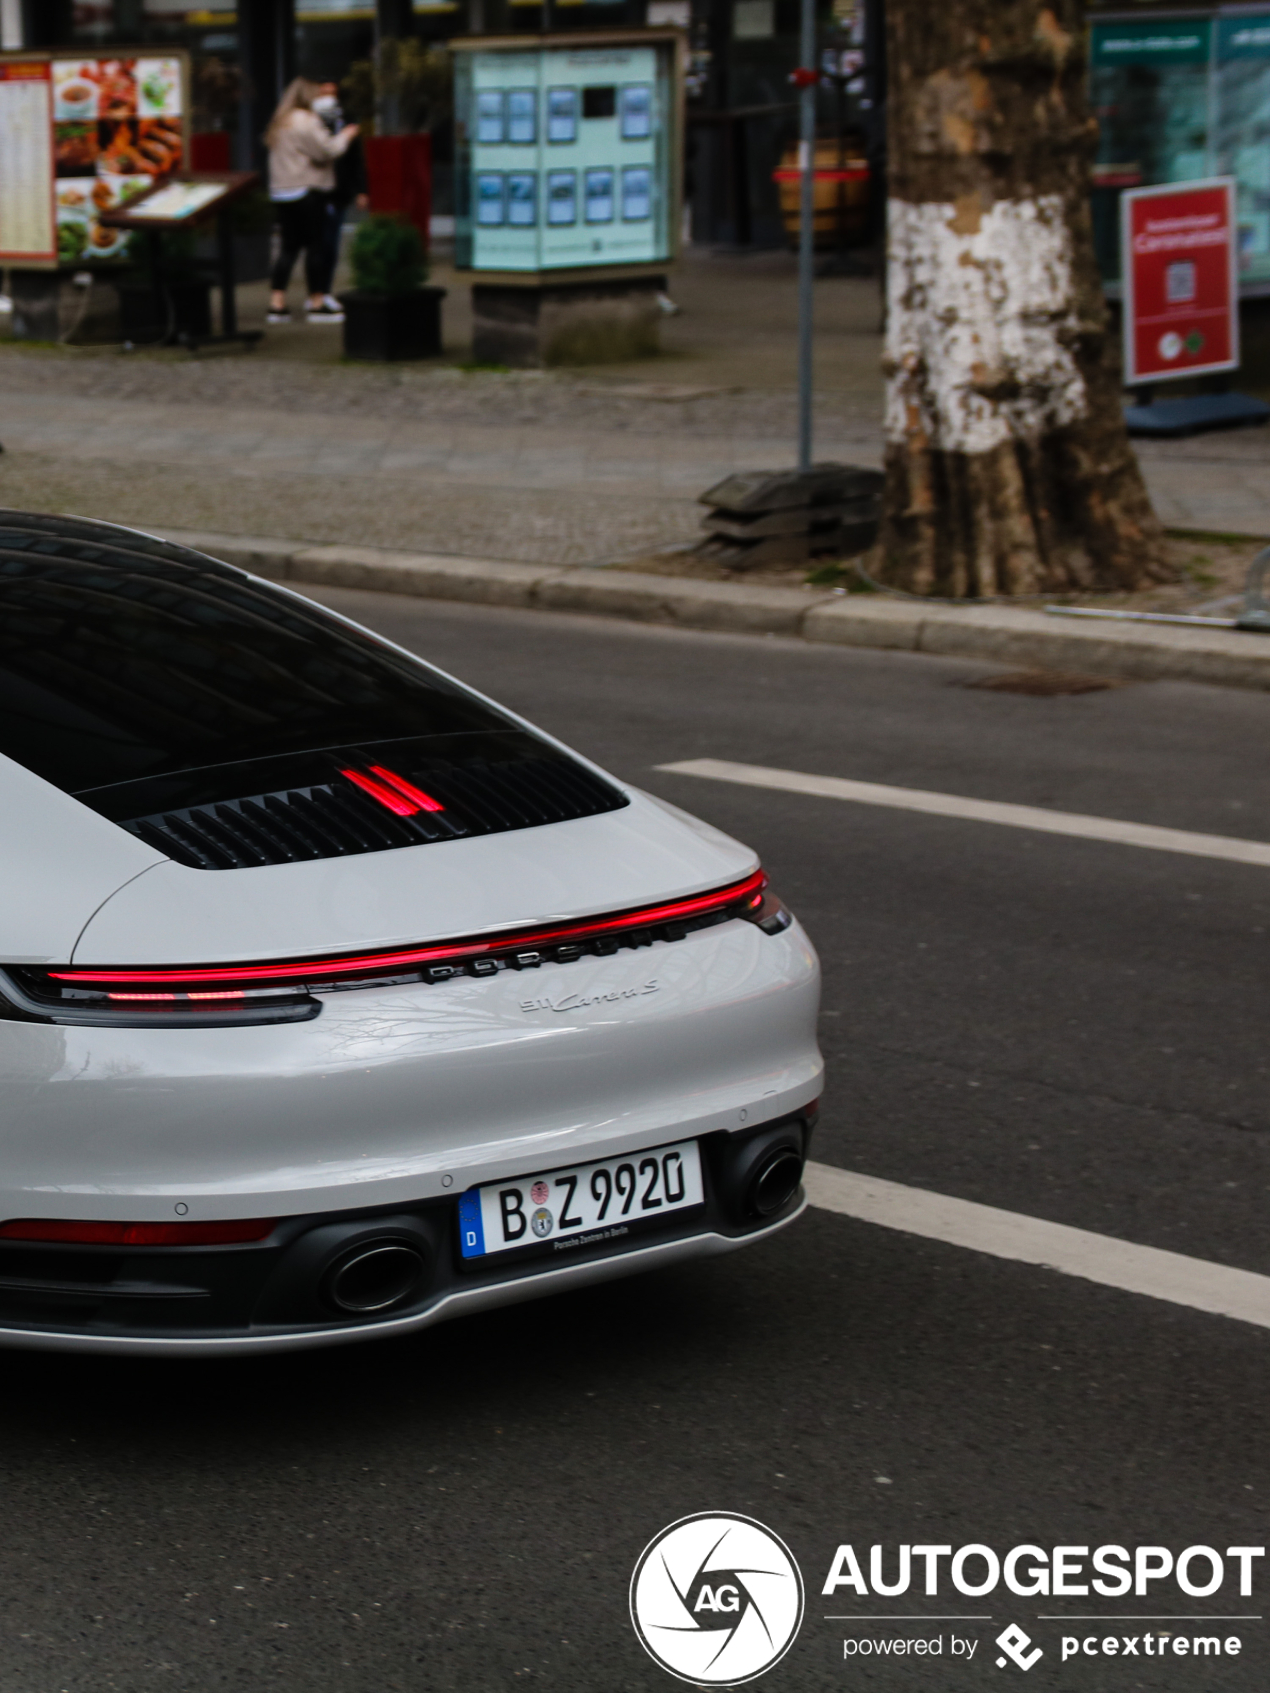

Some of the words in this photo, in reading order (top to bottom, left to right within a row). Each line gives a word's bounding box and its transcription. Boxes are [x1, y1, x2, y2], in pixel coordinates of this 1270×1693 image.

[424, 927, 687, 984] PORSCHE
[519, 1000, 552, 1013] 911
[552, 989, 639, 1012] Carrera
[644, 980, 661, 994] S
[499, 1188, 527, 1242] B
[555, 1175, 582, 1229] Z
[591, 1152, 686, 1221] 9920
[466, 1231, 477, 1247] D
[553, 1238, 579, 1250] Porsche
[610, 1226, 629, 1237] Berlin
